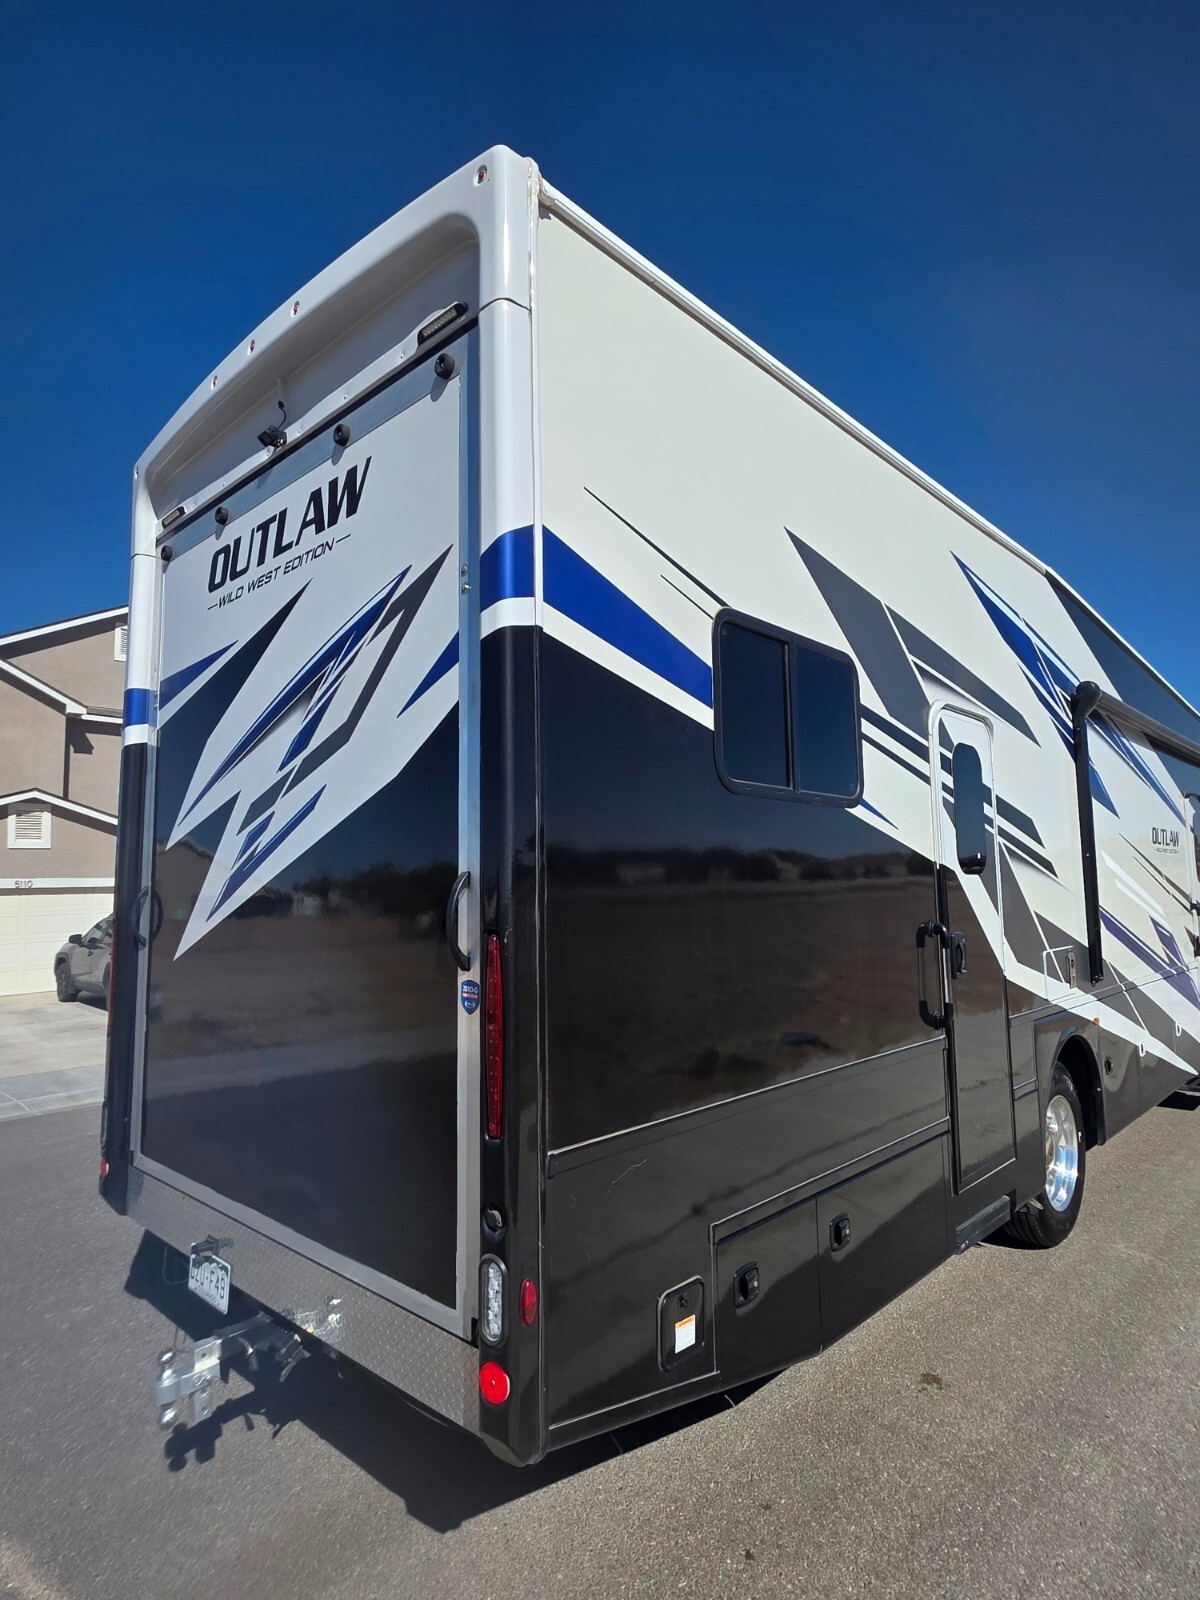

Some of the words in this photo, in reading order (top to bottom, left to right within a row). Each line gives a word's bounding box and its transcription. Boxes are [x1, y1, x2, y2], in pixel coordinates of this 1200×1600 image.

[208, 456, 372, 593] OUTLAW
[218, 586, 244, 608] WILD
[247, 566, 281, 593] WEST
[283, 537, 335, 575] EDITION
[1152, 827, 1179, 847] OUTLAW
[15, 880, 33, 888] 5110
